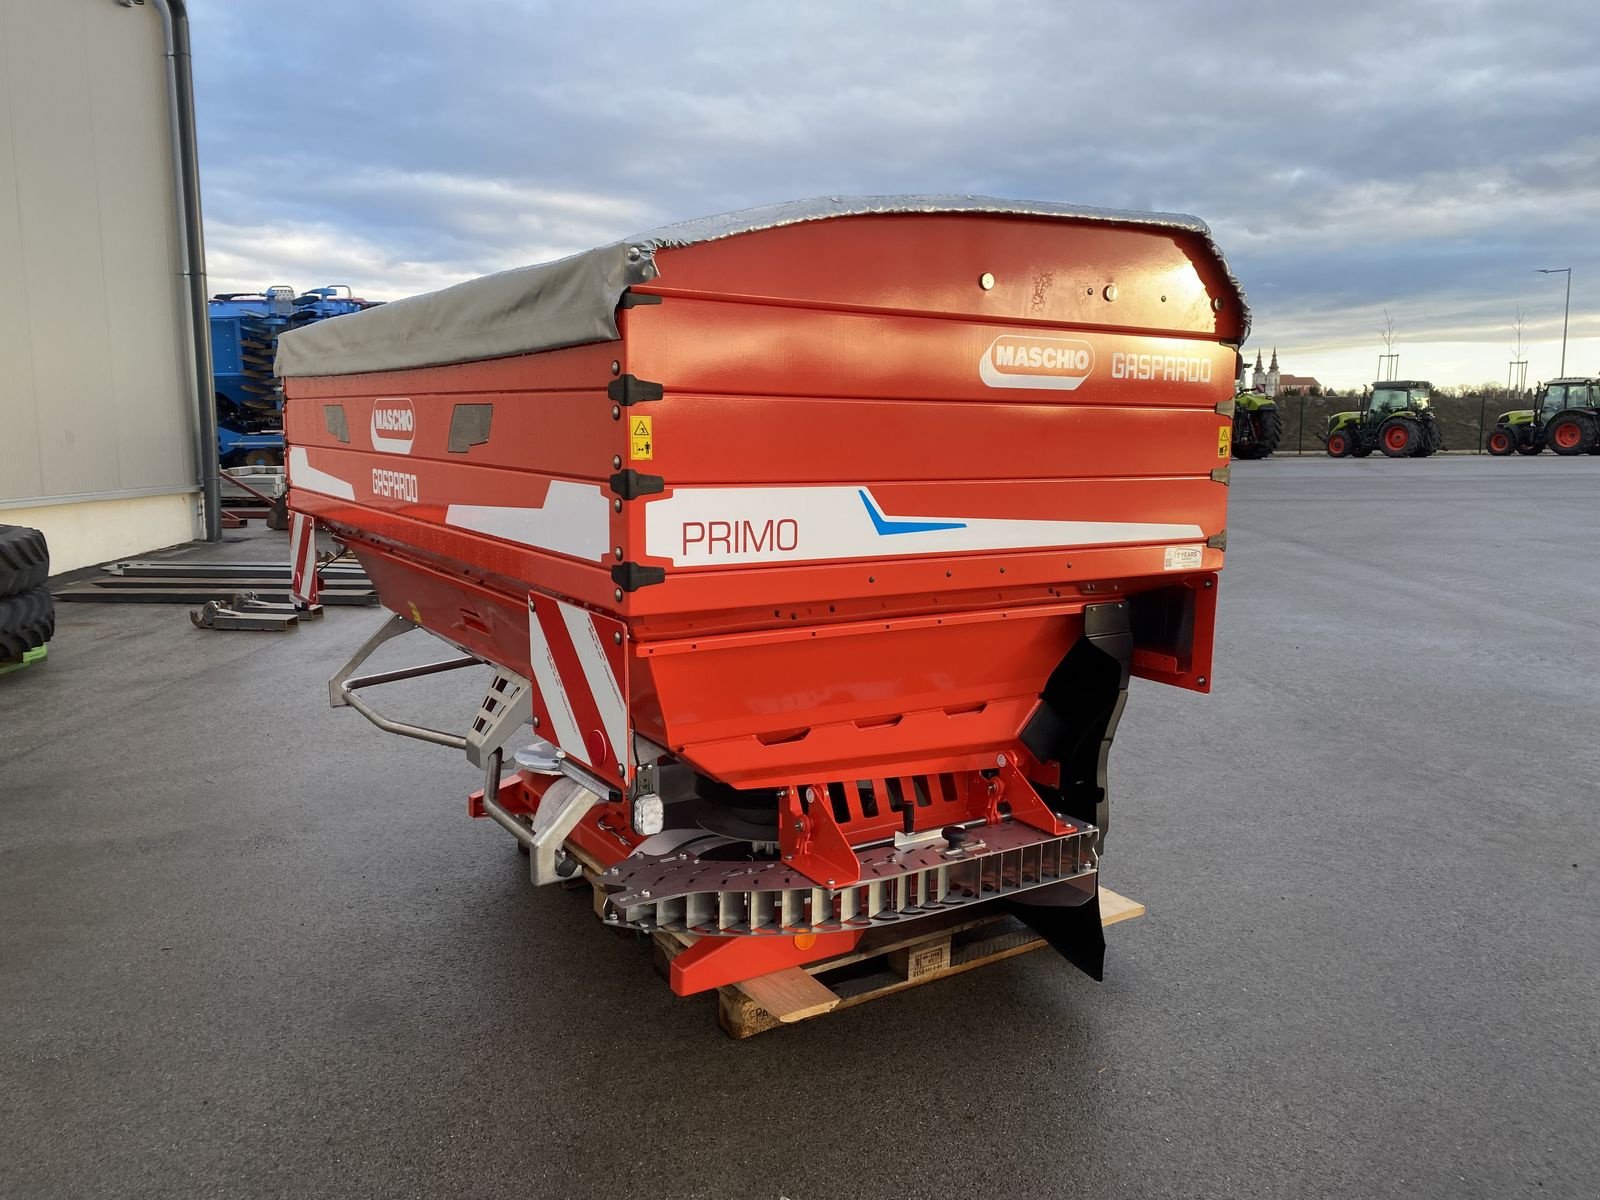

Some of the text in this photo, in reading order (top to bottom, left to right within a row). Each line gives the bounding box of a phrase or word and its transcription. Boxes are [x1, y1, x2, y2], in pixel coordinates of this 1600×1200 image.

[996, 345, 1212, 383] MASCHIO GASPARDO
[375, 408, 413, 432] MASCHIO
[372, 468, 418, 503] GASPARDO
[682, 518, 798, 556] PRIMO
